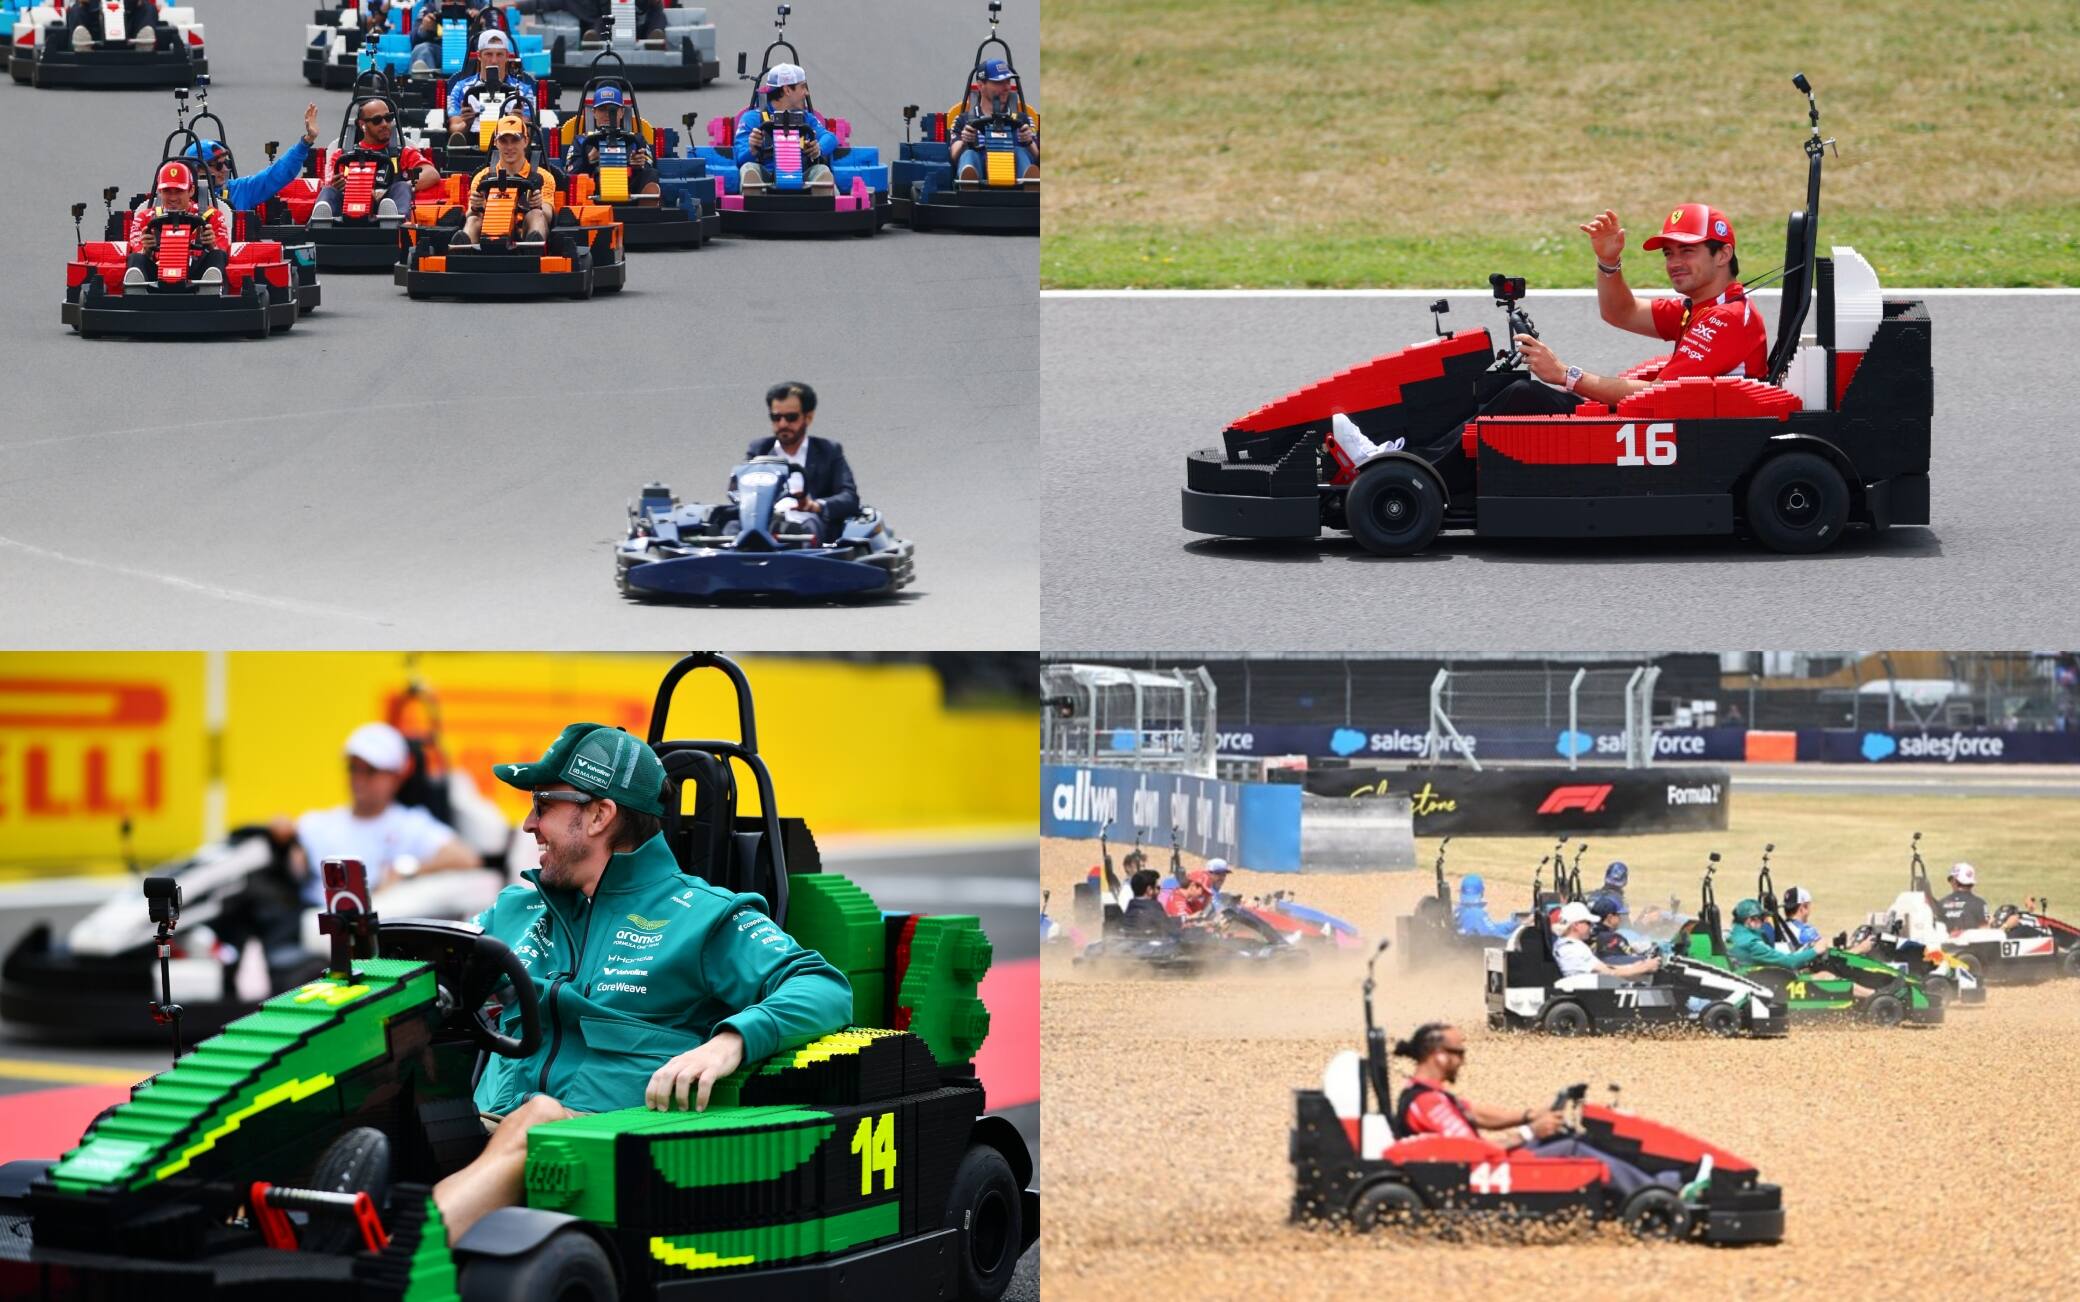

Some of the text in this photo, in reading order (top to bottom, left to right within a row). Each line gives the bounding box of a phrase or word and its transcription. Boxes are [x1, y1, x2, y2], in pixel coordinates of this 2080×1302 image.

[1616, 423, 1677, 466] 16
[1597, 731, 1705, 758] salforce
[1900, 732, 2003, 762] salesforce
[1537, 784, 1613, 814] F1
[616, 930, 663, 944] aramco
[2002, 941, 2020, 957] 87
[597, 982, 647, 994] CoreWeave
[1614, 989, 1638, 1009] 77
[1786, 981, 1807, 999] 14
[850, 1112, 897, 1196] 14
[1469, 1161, 1513, 1195] 44
